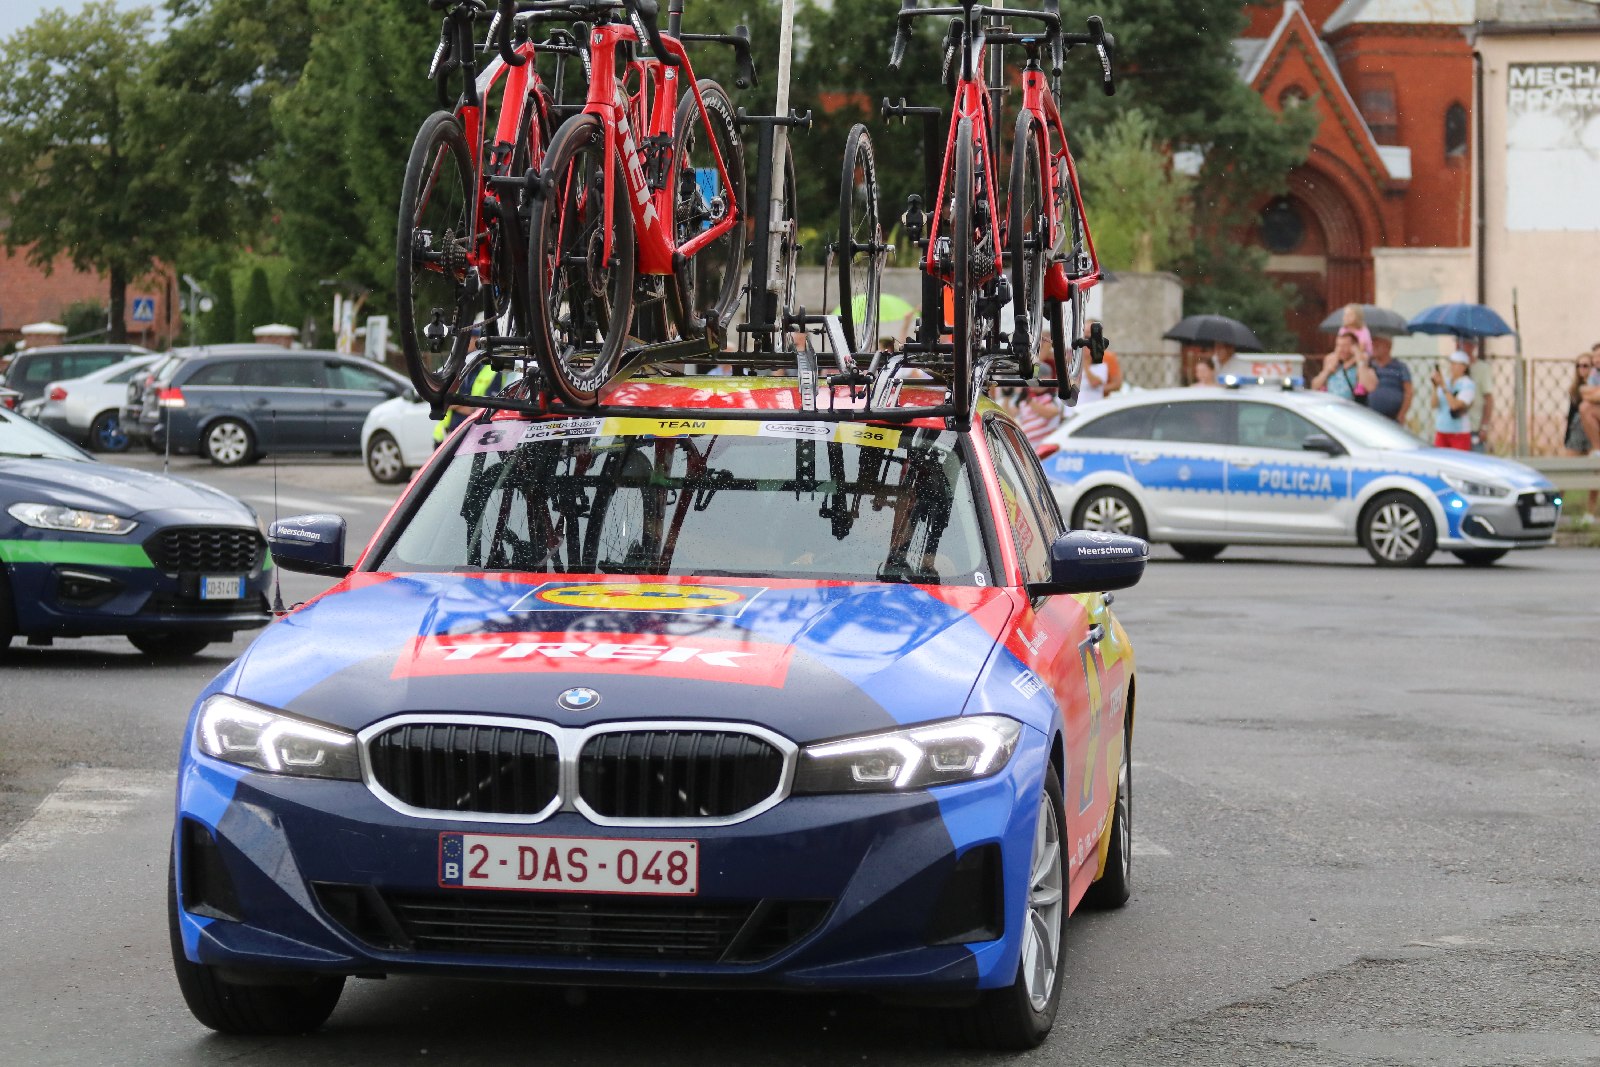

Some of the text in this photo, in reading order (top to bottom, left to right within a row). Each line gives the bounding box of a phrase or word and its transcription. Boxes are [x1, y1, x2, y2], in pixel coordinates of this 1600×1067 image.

[1509, 66, 1600, 86] MECH
[691, 96, 738, 146] BONTRA
[552, 325, 609, 392] ONTRAGER
[658, 421, 706, 429] TEAM
[478, 430, 506, 446] 8
[525, 431, 549, 439] UCI
[854, 431, 884, 441] 236
[1258, 469, 1332, 493] POLICJA
[1078, 546, 1133, 555] Meerschman
[435, 641, 758, 668] TREK
[445, 862, 459, 879] B
